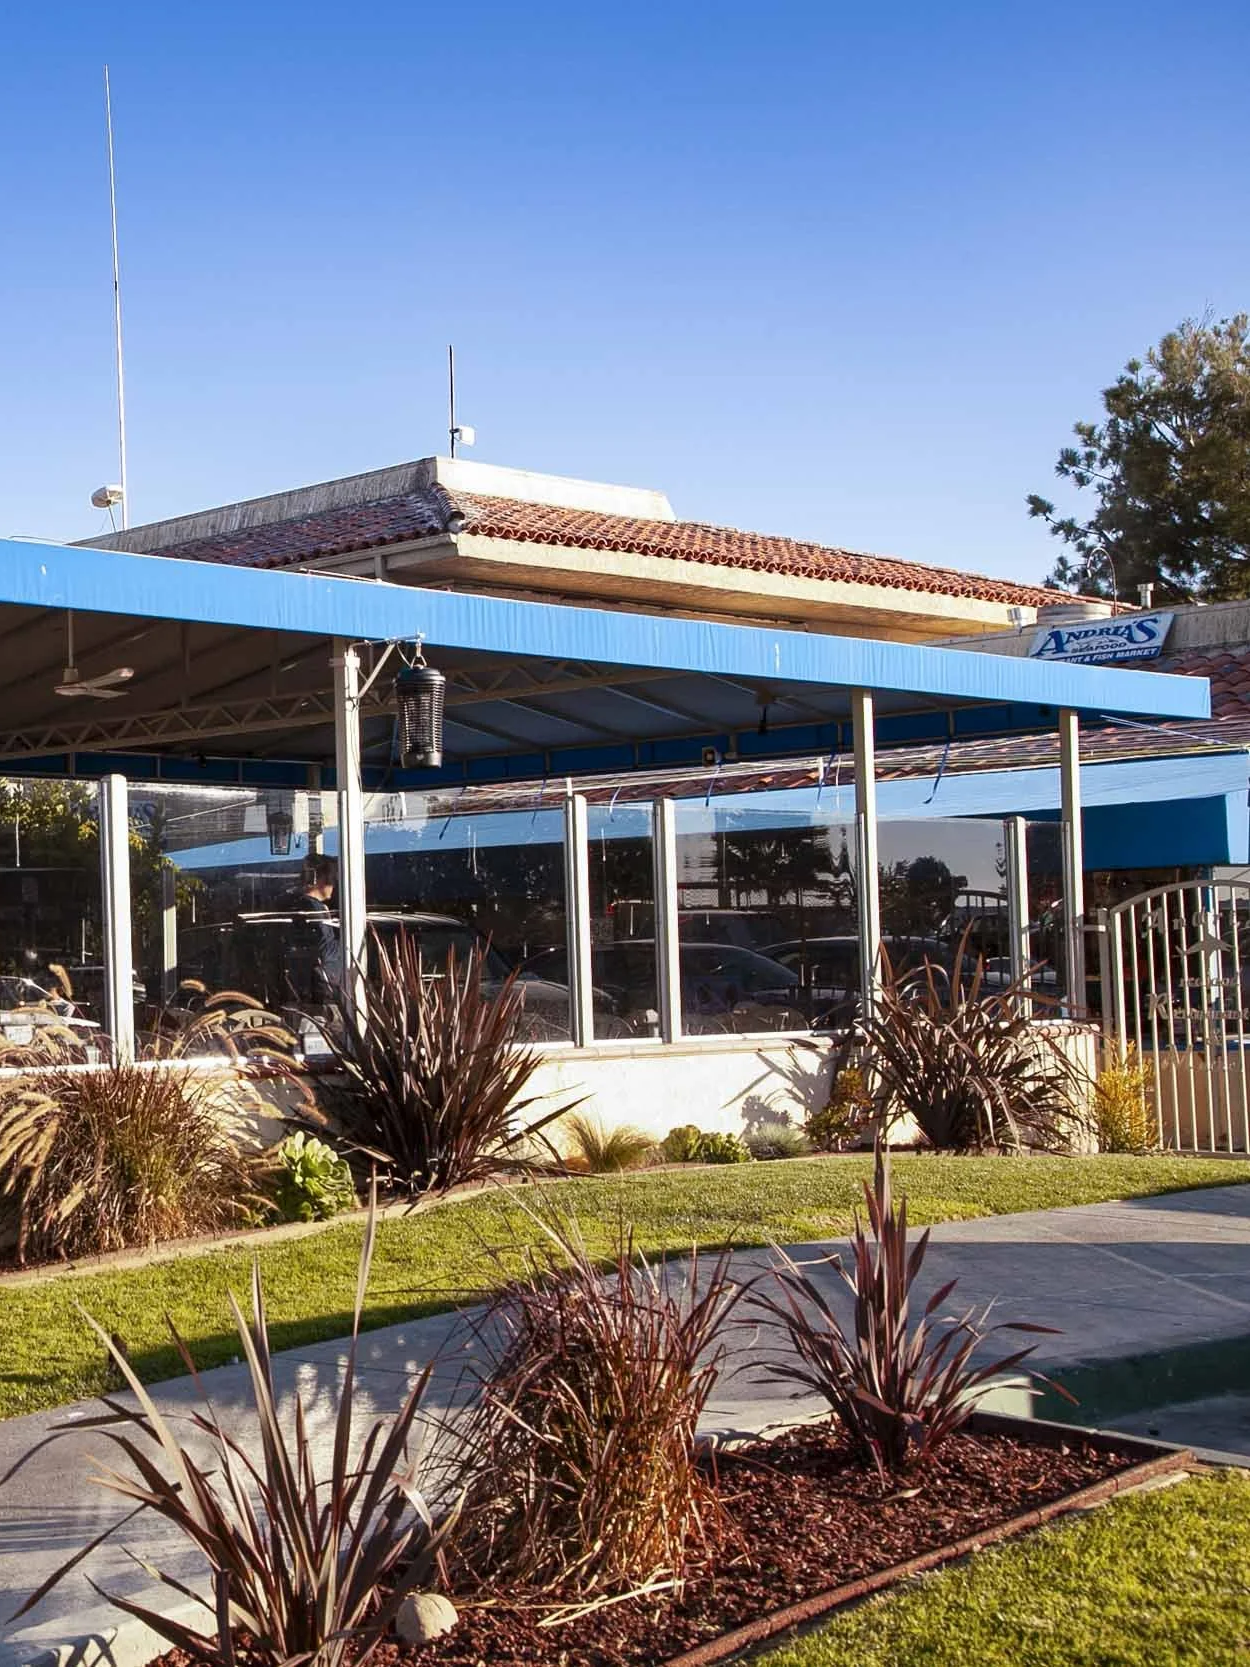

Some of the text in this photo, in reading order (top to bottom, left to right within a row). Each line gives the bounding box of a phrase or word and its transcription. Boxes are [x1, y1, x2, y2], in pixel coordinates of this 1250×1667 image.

[1071, 642, 1127, 654] SEAFOOD
[1092, 653, 1114, 662] FISH
[1116, 648, 1157, 659] MARKET
